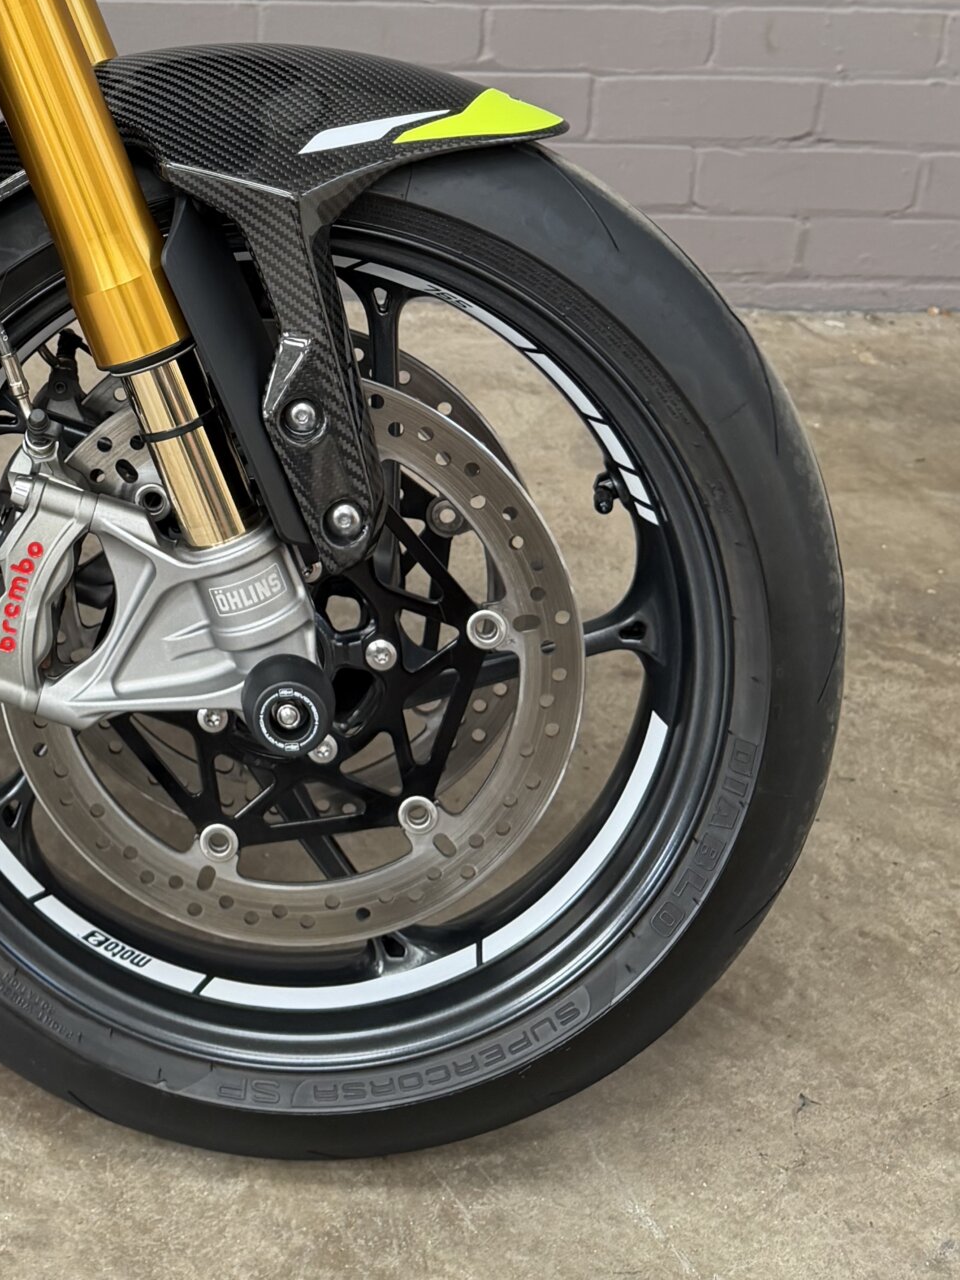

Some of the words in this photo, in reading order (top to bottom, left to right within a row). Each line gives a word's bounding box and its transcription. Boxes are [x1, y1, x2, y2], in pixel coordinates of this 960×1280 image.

[214, 573, 282, 612] ÖHLINS
[650, 738, 758, 938] DIABLO
[82, 930, 152, 968] moto2
[312, 1000, 582, 1103] SUPERCORSA
[216, 1077, 281, 1104] SP
